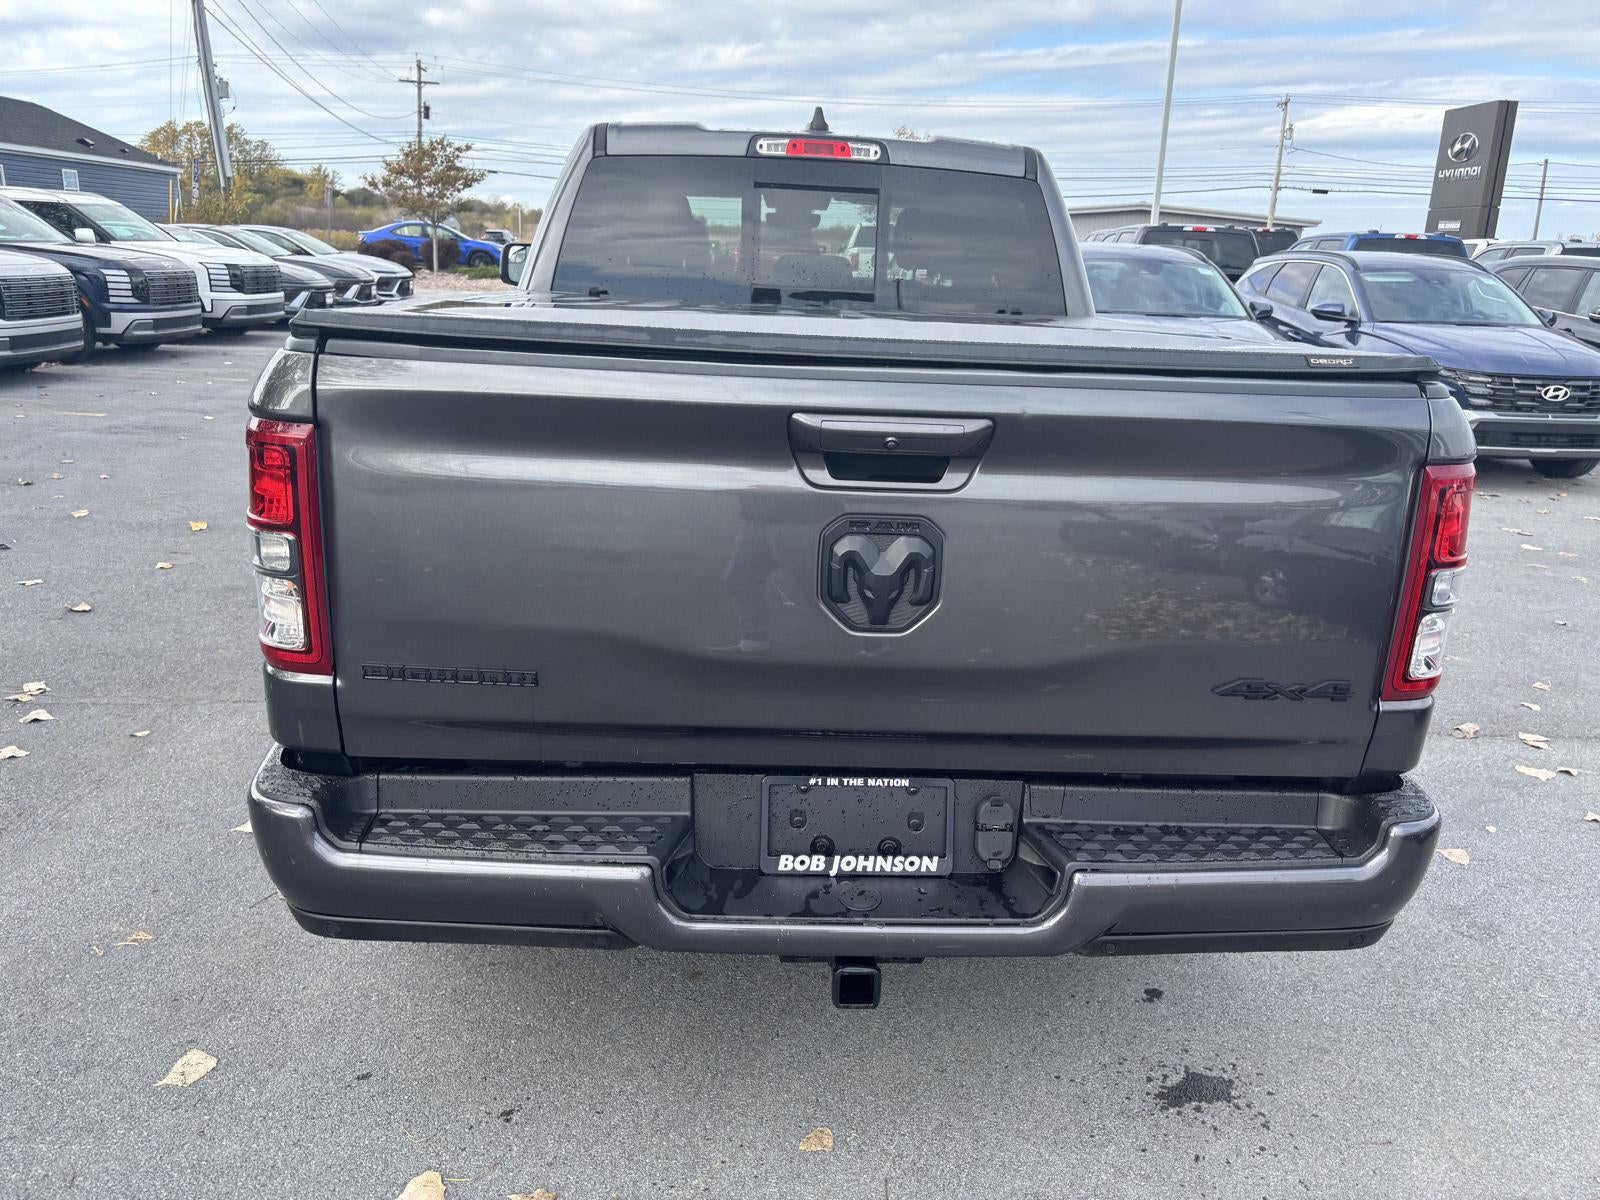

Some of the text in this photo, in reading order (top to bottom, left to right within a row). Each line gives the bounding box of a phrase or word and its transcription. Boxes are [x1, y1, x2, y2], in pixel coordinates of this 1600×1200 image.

[849, 521, 920, 532] RAM
[808, 778, 910, 787] #1 IN THE NATION
[778, 854, 939, 877] BOB JOHNSON
